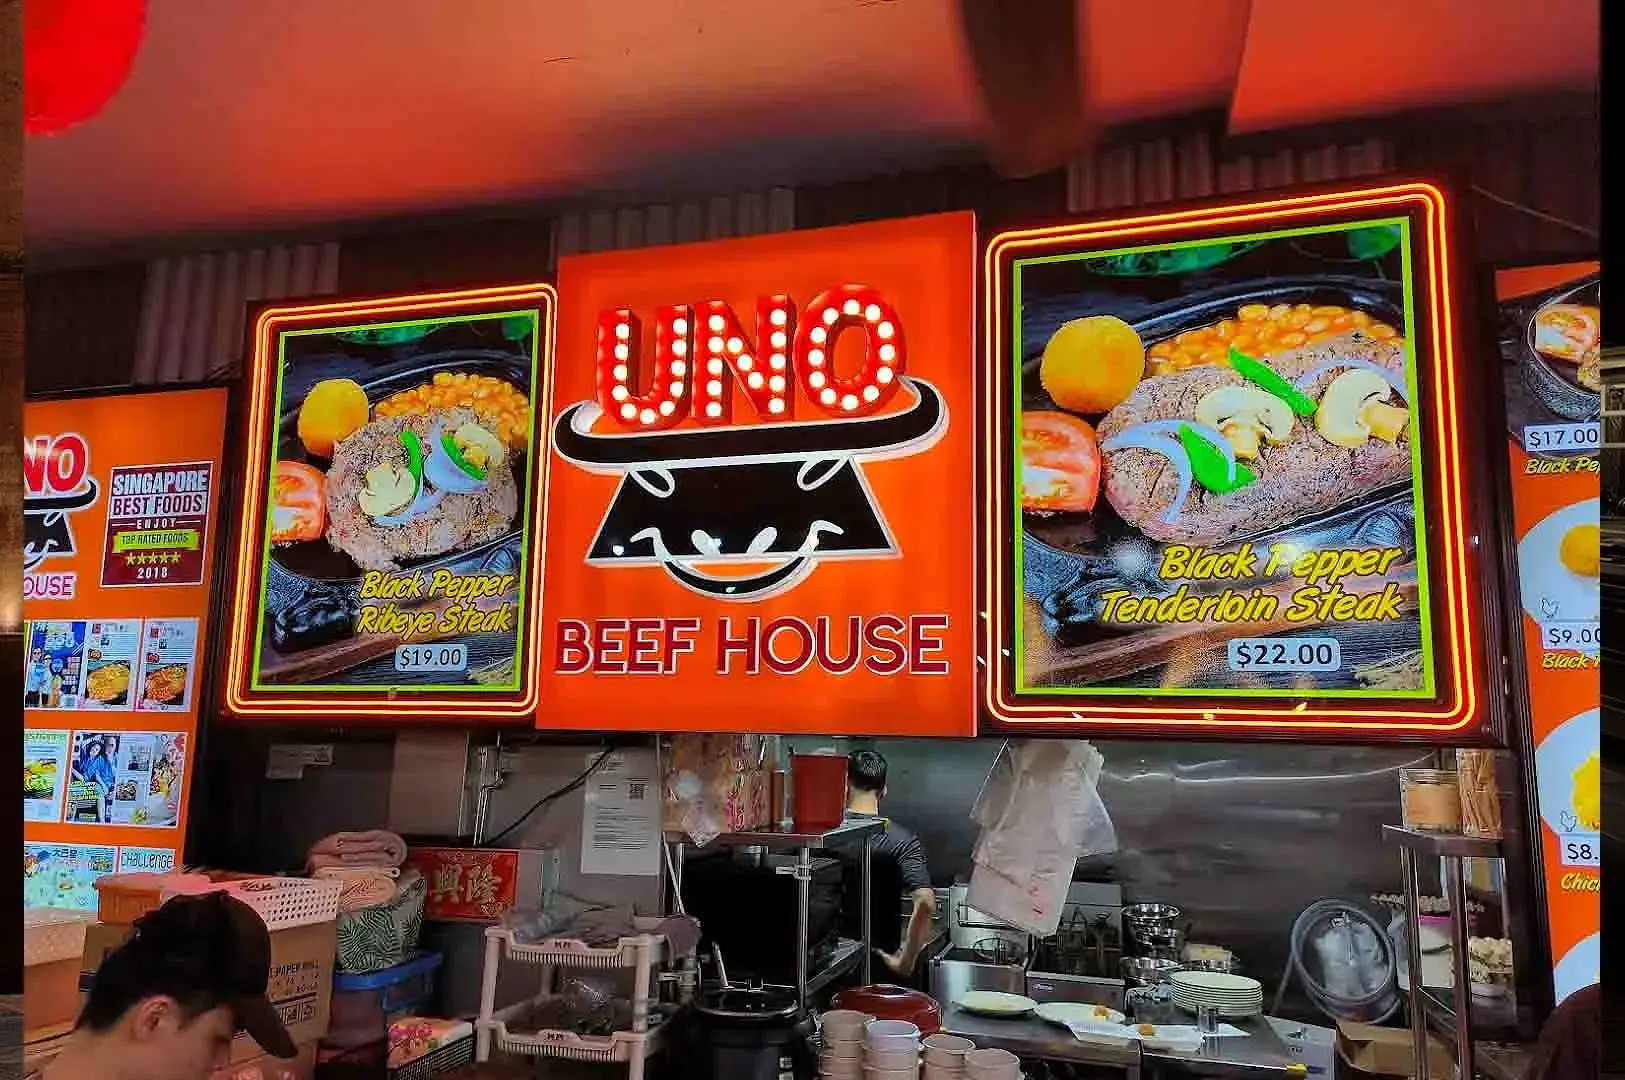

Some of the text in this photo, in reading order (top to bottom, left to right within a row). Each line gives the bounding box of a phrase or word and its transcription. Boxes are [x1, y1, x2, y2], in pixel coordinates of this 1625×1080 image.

[596, 283, 906, 429] UNO
[1529, 429, 1598, 448] $17.00
[1525, 456, 1600, 475] Black Pe
[113, 470, 208, 495] SINGAPORE
[113, 494, 203, 516] BEST FOODS
[136, 518, 177, 529] ENJOY
[122, 535, 136, 545] TOP
[137, 533, 161, 544] RATED
[137, 566, 168, 579] 2018
[1158, 543, 1257, 580] Black
[359, 568, 515, 604] Black Pepper
[1100, 582, 1405, 624] Tenderloin Steak
[357, 602, 513, 641] Ribeye Steak
[554, 614, 950, 676] BEEF HOUSE
[1236, 642, 1334, 669] $22.00
[400, 647, 462, 668] $19.00
[1543, 652, 1589, 670] Black
[1560, 872, 1600, 891] Chic
